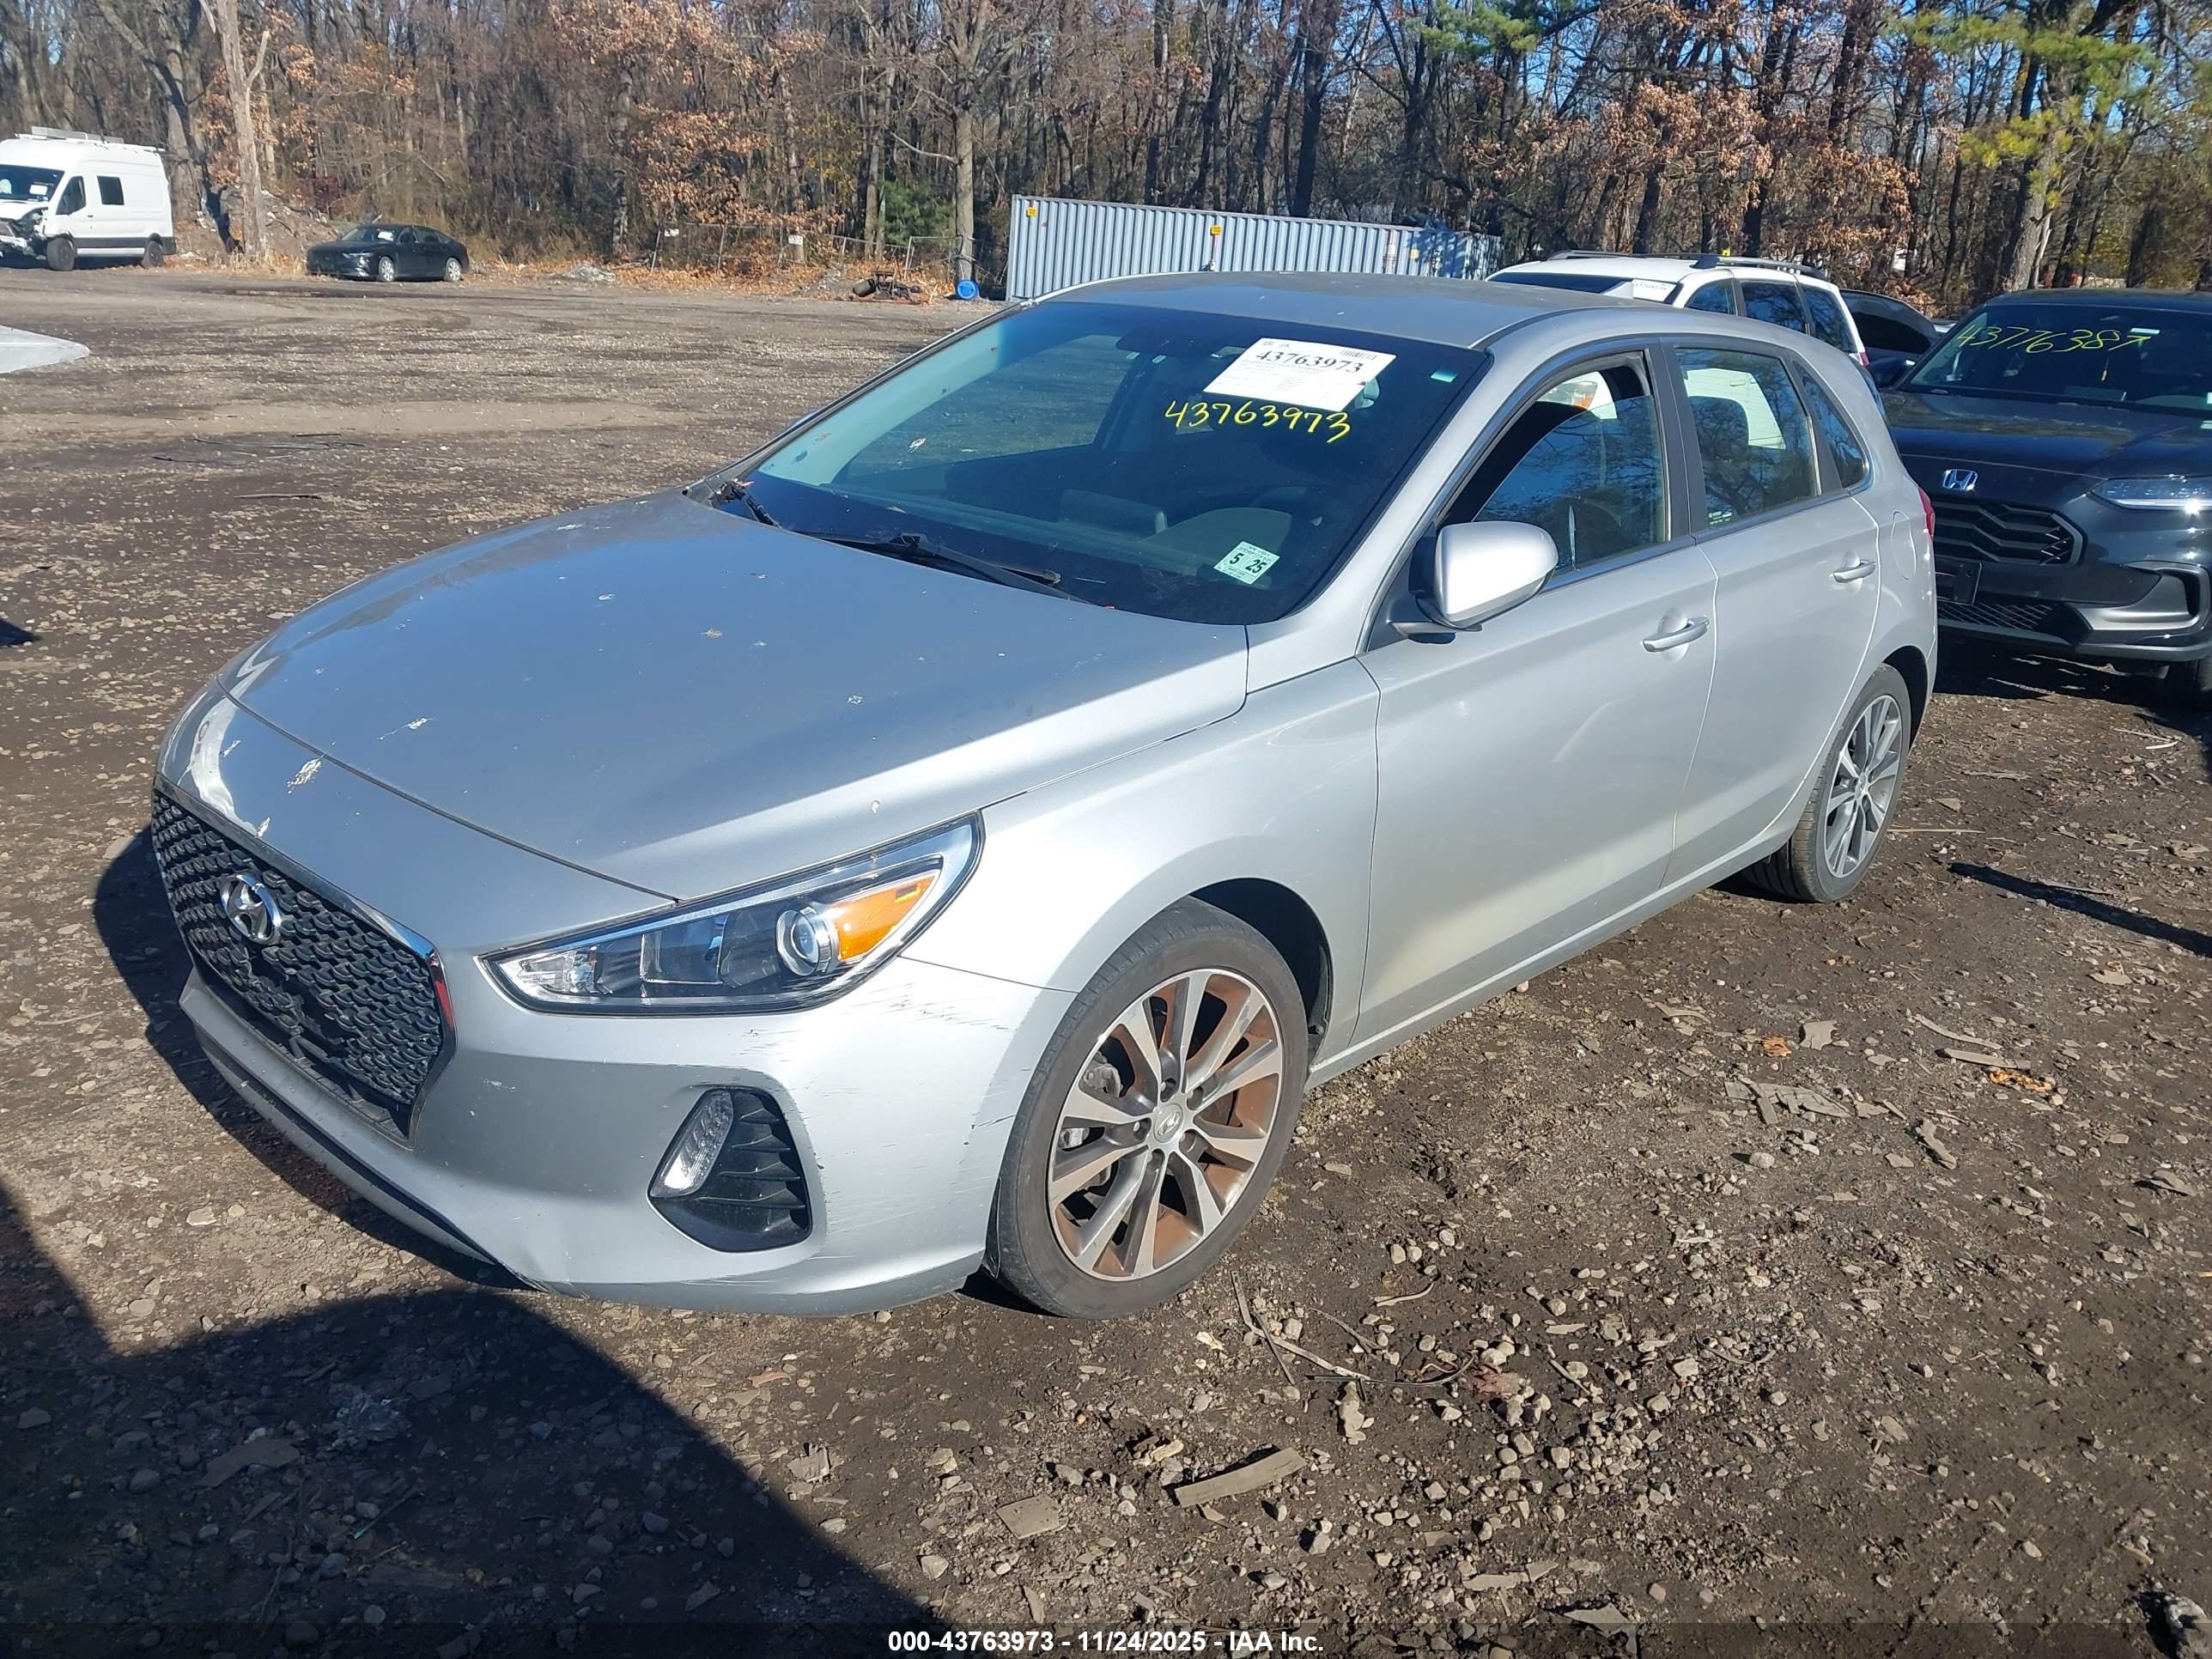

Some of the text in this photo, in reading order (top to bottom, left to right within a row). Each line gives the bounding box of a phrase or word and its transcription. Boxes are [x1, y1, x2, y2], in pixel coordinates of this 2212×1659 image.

[1957, 324, 2152, 354] 43776387
[1255, 349, 1364, 374] 43763973
[1164, 400, 1351, 443] 43763973
[1229, 552, 1245, 565] 5
[1244, 559, 1268, 574] 25
